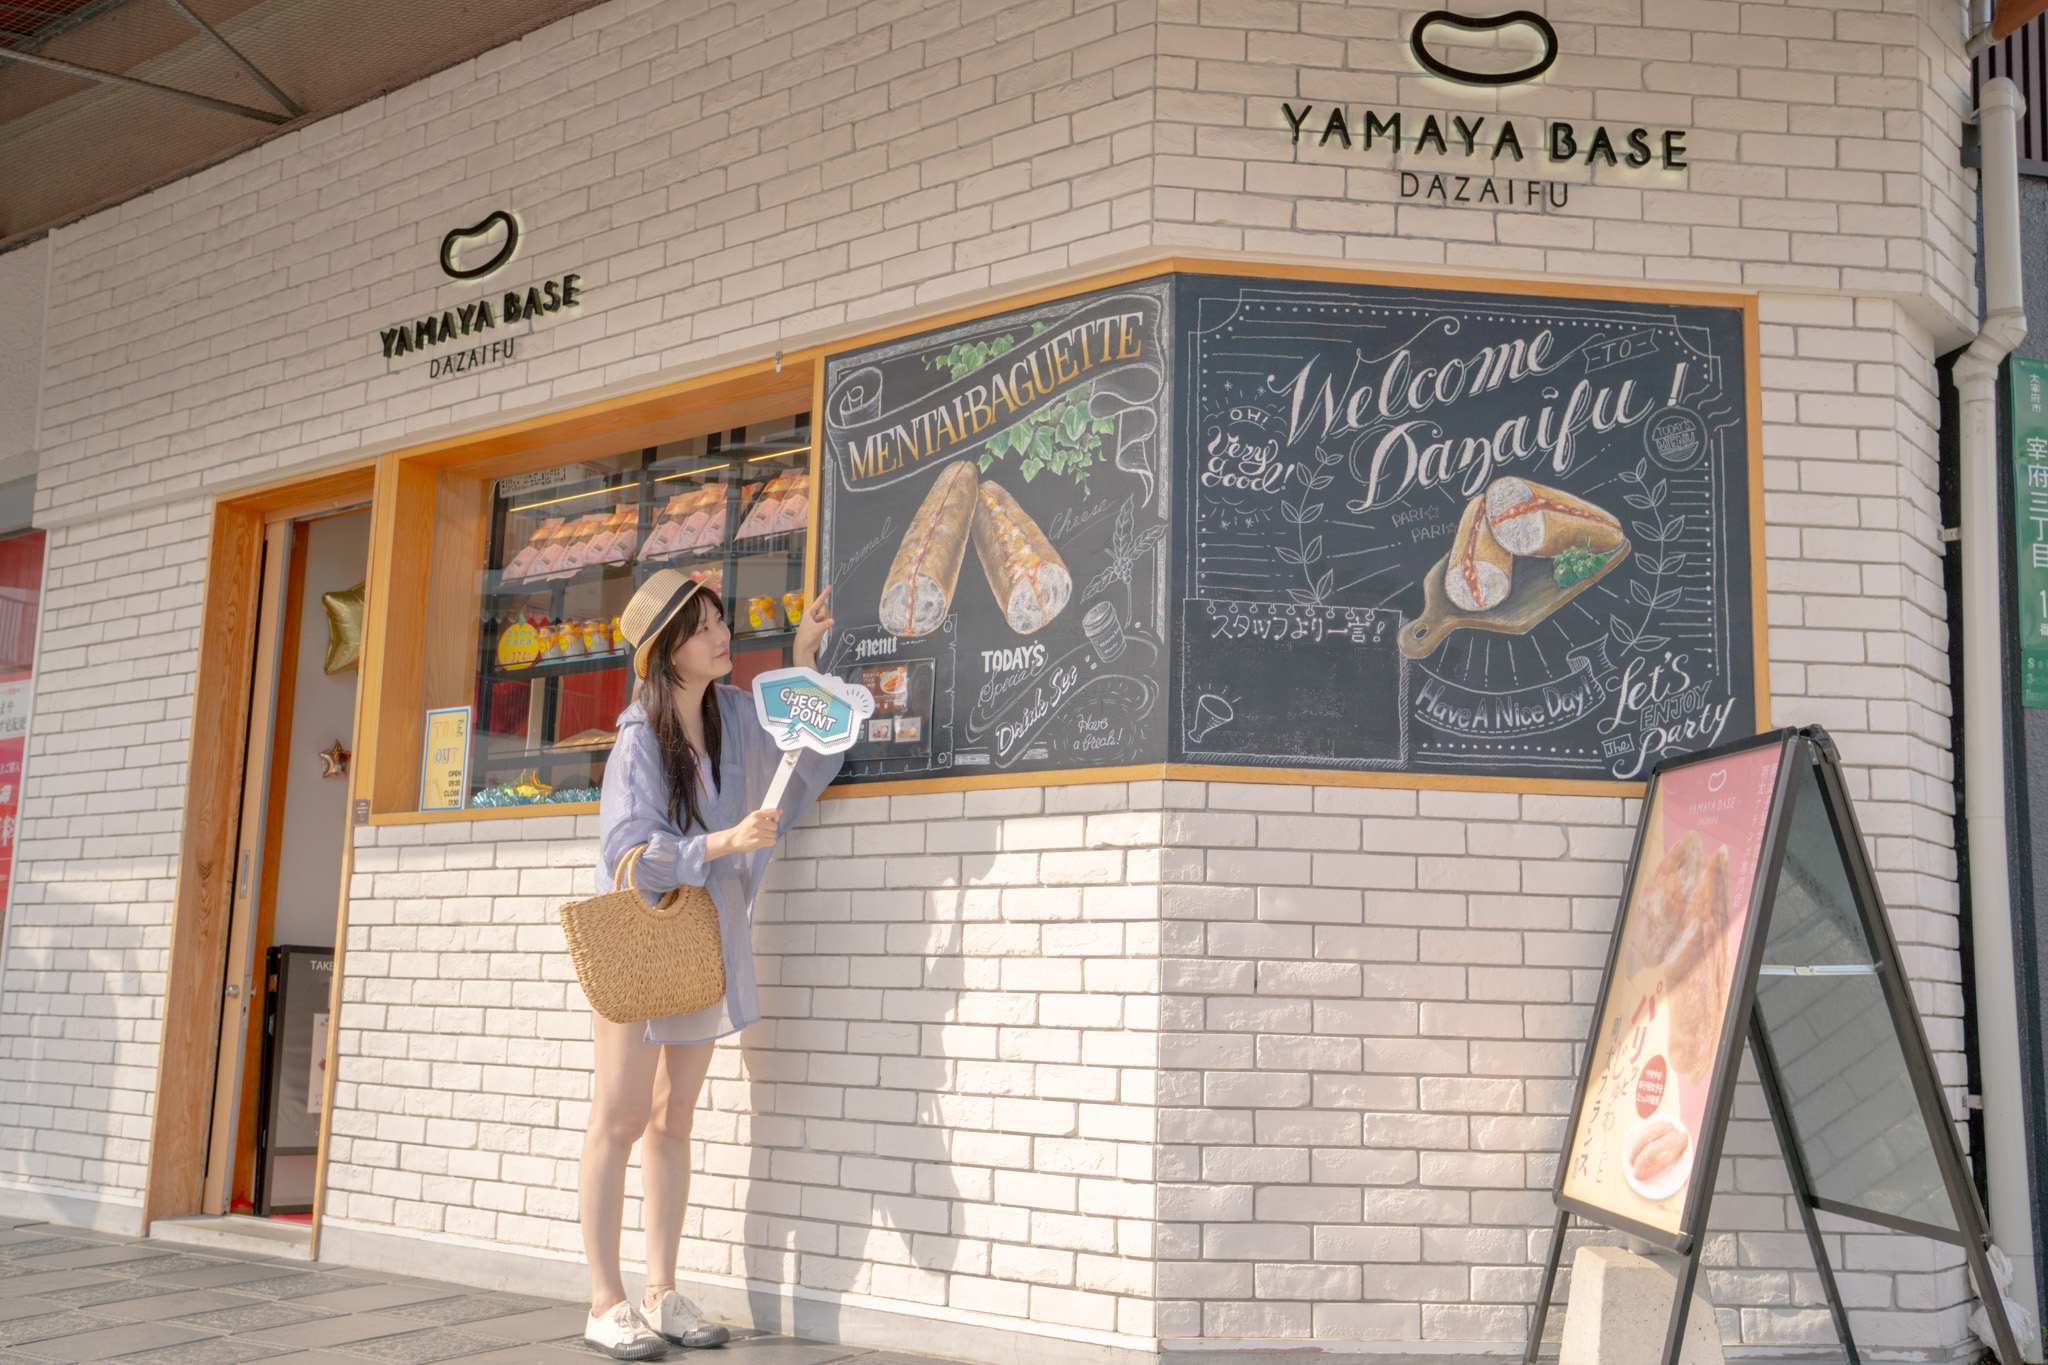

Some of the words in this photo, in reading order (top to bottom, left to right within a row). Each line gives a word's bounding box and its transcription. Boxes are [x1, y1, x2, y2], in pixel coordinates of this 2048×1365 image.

[1282, 102, 1524, 162] YAMAYA
[1548, 121, 1688, 171] BASE
[1401, 172, 1569, 208] DAZAIFU
[380, 300, 495, 359] YAMAYA
[503, 273, 581, 324] BASE
[430, 338, 515, 379] DAZAIFU
[848, 311, 1143, 481] MENTAI-BAGUETTE
[1266, 328, 1556, 448] Welcome
[2029, 373, 2042, 413] 太宰府市
[1230, 408, 1268, 427] OH!
[1656, 419, 1692, 437] TODAY'S
[1207, 425, 1279, 475] Very
[1656, 432, 1695, 452] MENU
[1201, 456, 1295, 494] good!
[1049, 498, 1108, 541] Cheese
[506, 628, 534, 638] きんかん
[981, 640, 1046, 673] TODAY'S
[977, 652, 1049, 708] Special
[1597, 651, 1691, 735] Let's
[778, 686, 829, 717] CHECK
[788, 704, 838, 732] POINT
[995, 688, 1050, 757] Drink
[1049, 664, 1078, 708] Set
[1415, 678, 1472, 726] Have
[1471, 693, 1489, 729] A
[1495, 696, 1545, 729] Nice
[1542, 675, 1594, 719] Day!
[1639, 680, 1713, 731] ENJOY
[1072, 740, 1081, 750] a
[1081, 727, 1123, 750] break!
[1077, 713, 1109, 732] Have
[434, 747, 459, 765] OUT
[1605, 738, 1630, 756] The
[443, 789, 460, 797] CLOSE
[1688, 800, 1716, 816] YAMAYA
[1717, 796, 1737, 811] BASE
[1577, 1016, 1622, 1177] 明太フランス
